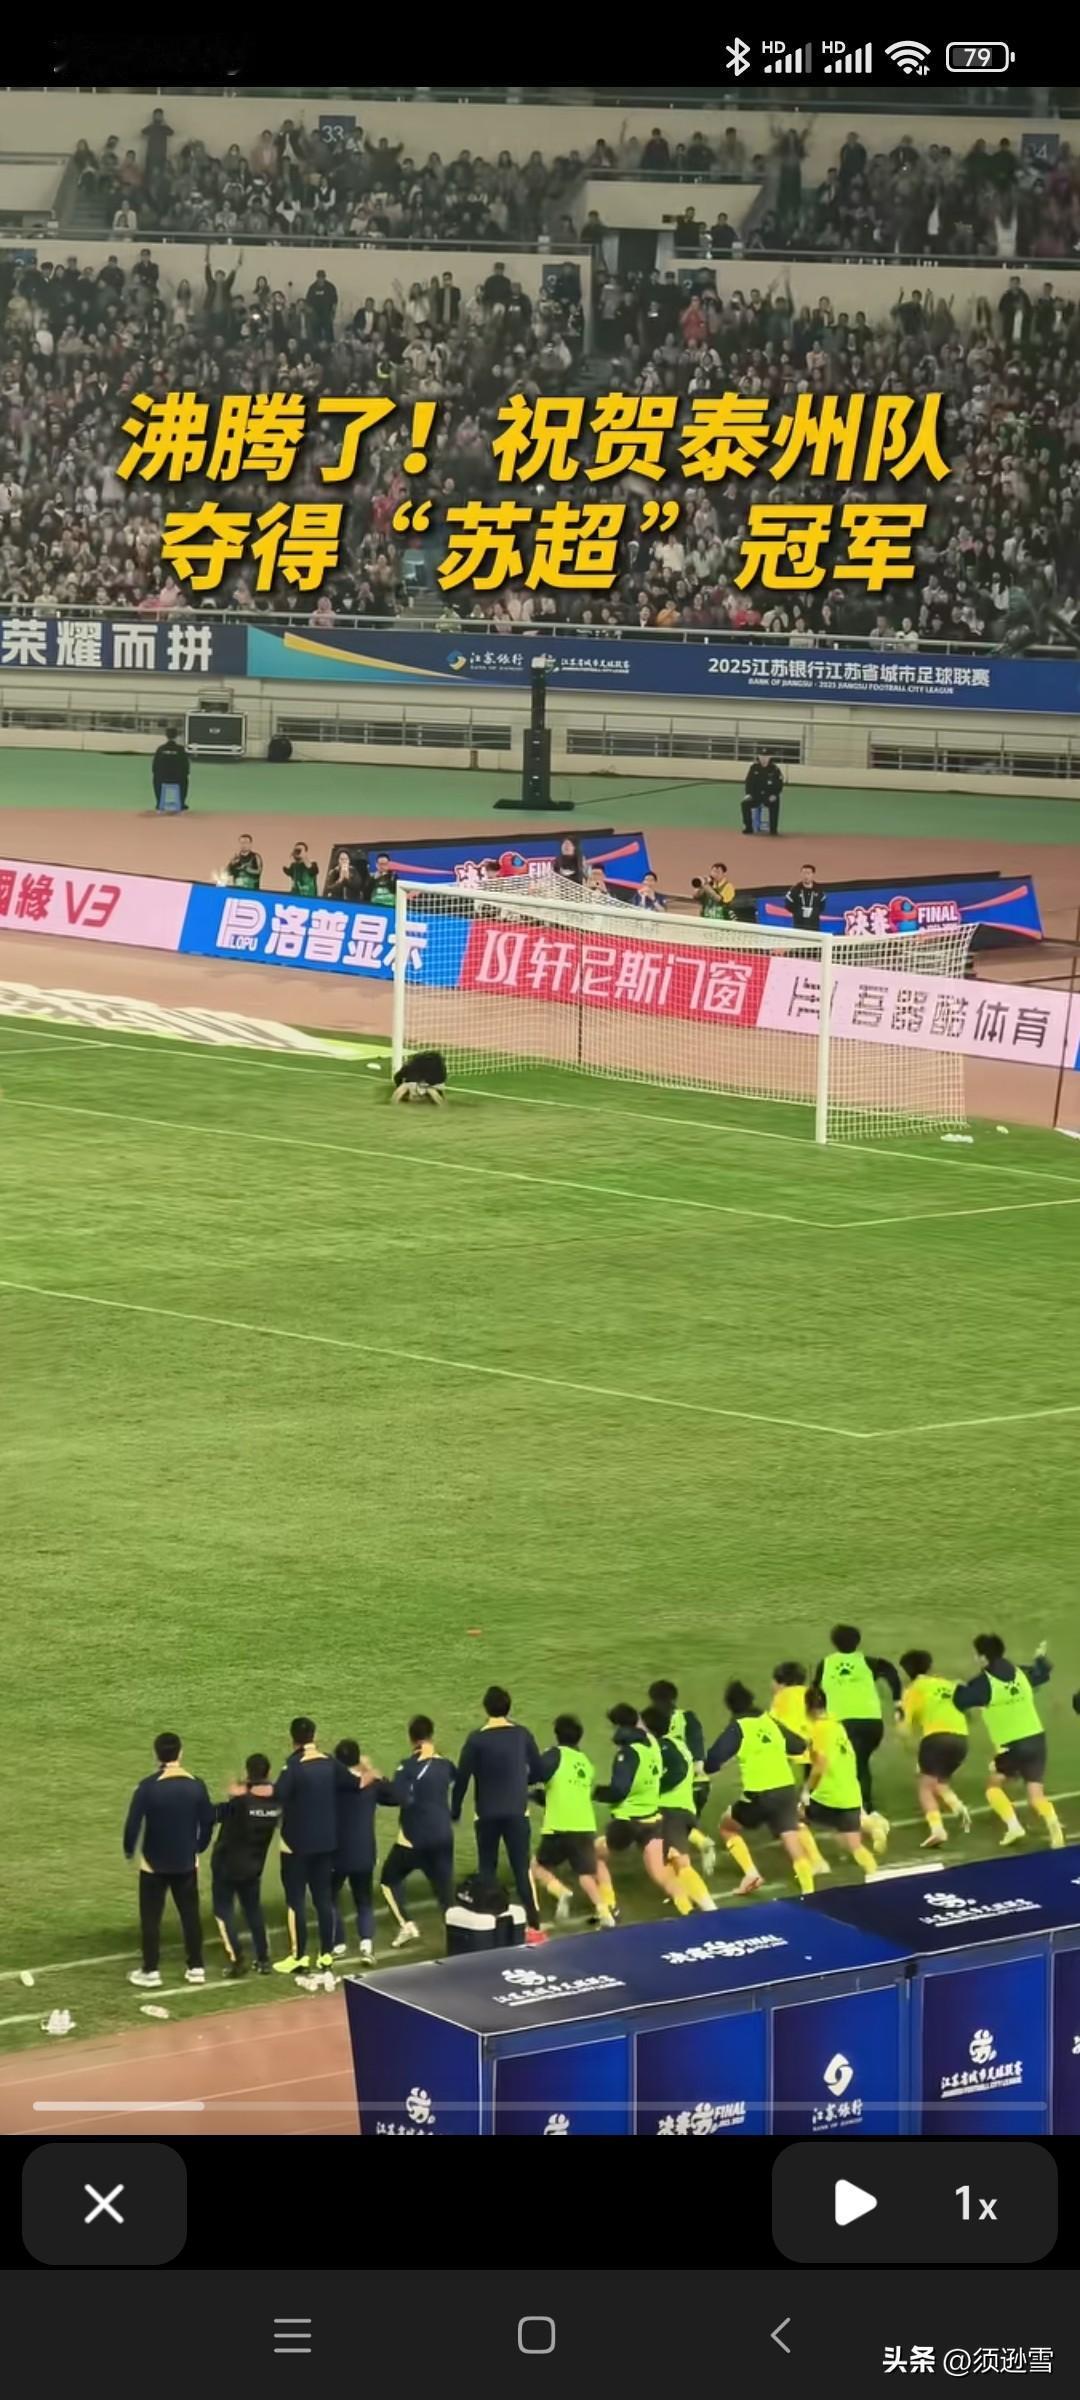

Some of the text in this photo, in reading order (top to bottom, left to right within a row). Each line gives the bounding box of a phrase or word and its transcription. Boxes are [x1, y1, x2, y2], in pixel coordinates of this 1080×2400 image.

[1, 618, 212, 671] 荣耀而拼
[708, 658, 990, 687] 2025江苏银行江苏省城市足球联赛
[65, 880, 121, 928] V3
[918, 904, 958, 923] FINAL
[526, 936, 753, 1015] 轩尼斯门窗
